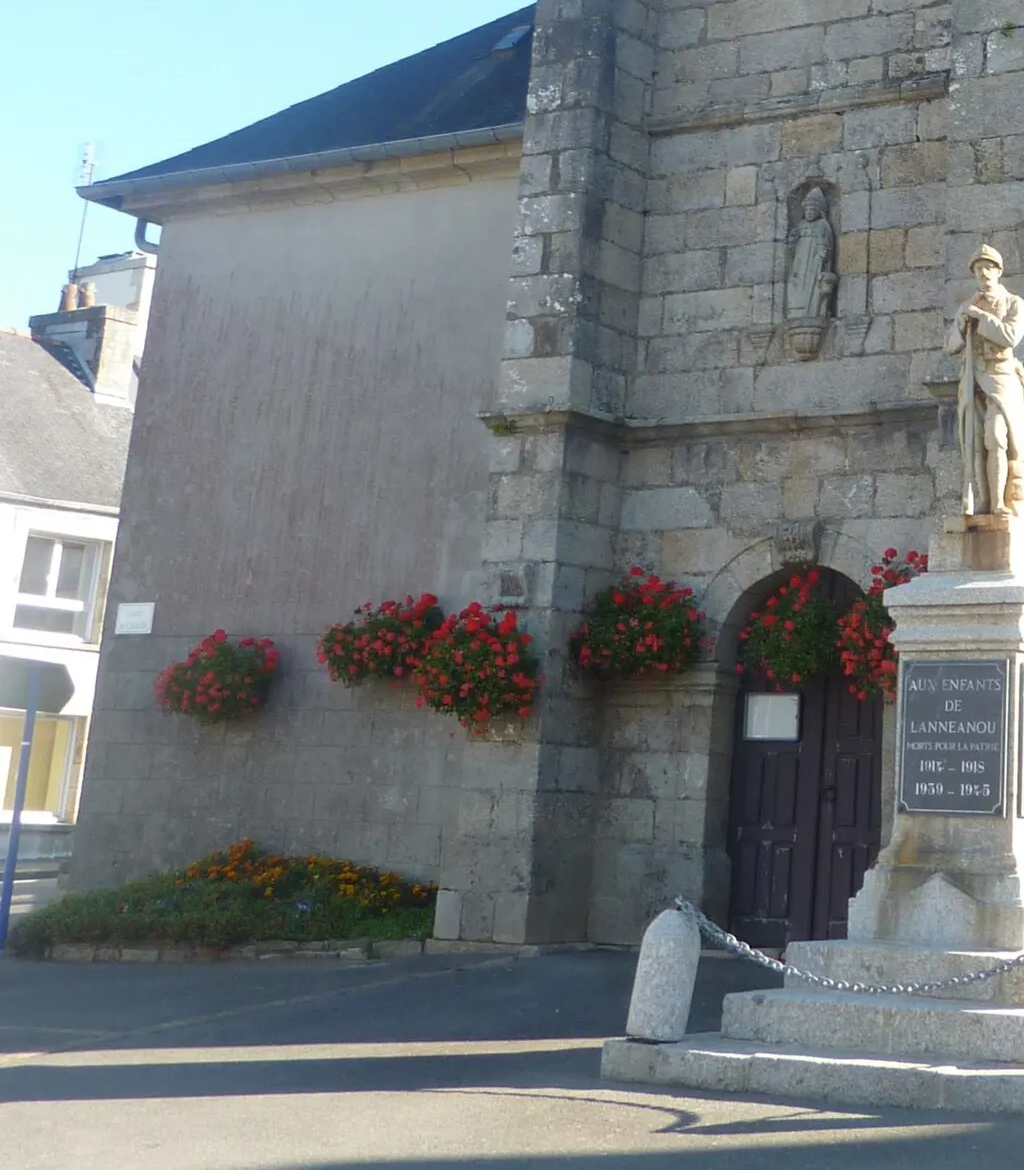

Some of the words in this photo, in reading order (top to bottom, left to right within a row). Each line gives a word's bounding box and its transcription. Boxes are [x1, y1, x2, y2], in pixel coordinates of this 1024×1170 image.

[909, 678, 936, 691] AUX
[941, 678, 1002, 691] ENFANTS
[944, 699, 962, 712] DE
[910, 721, 996, 734] LANNEANOU
[906, 741, 933, 750] MORTS
[934, 741, 956, 750] POUR
[957, 742, 968, 750] LA
[970, 742, 999, 750] PATRIE
[919, 759, 945, 772] 1914
[960, 760, 985, 773] 1918
[915, 782, 943, 795] 1939
[960, 783, 990, 796] 1945
